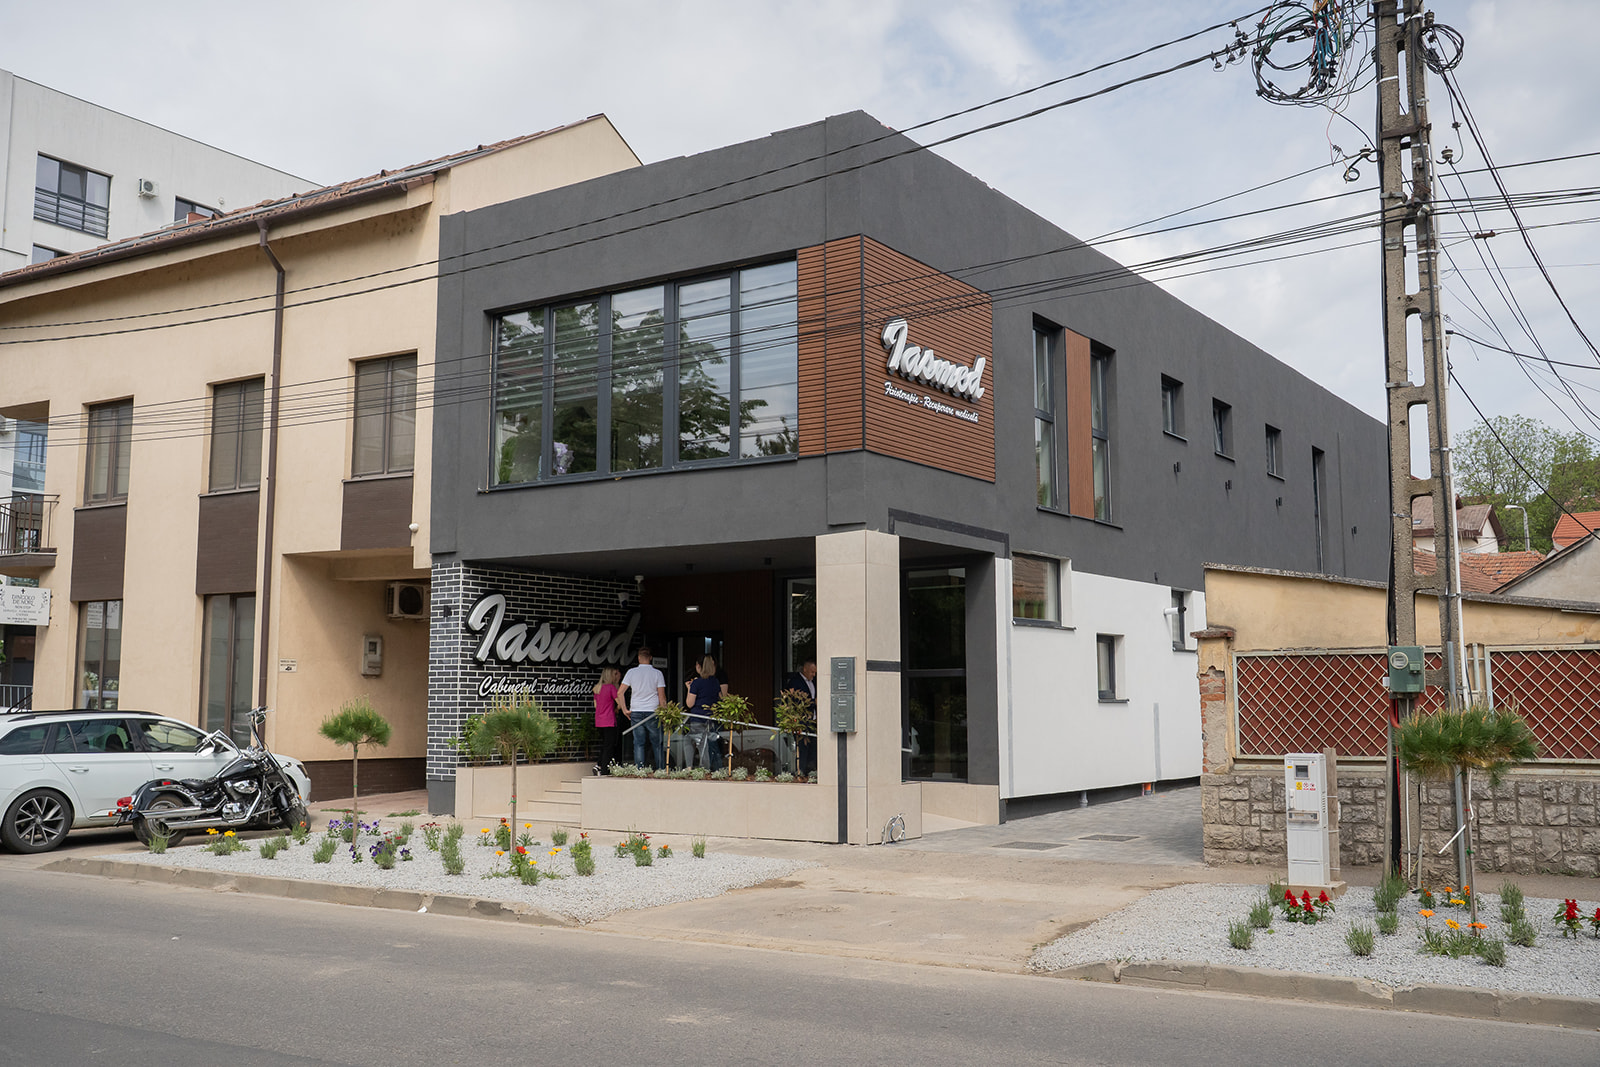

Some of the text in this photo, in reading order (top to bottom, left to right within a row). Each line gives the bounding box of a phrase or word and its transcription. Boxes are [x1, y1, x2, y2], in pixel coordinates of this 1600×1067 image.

[882, 318, 986, 400] Iasmed
[923, 395, 954, 413] Recuperare
[467, 593, 641, 666] Iasmed
[479, 675, 537, 696] Cabinetul
